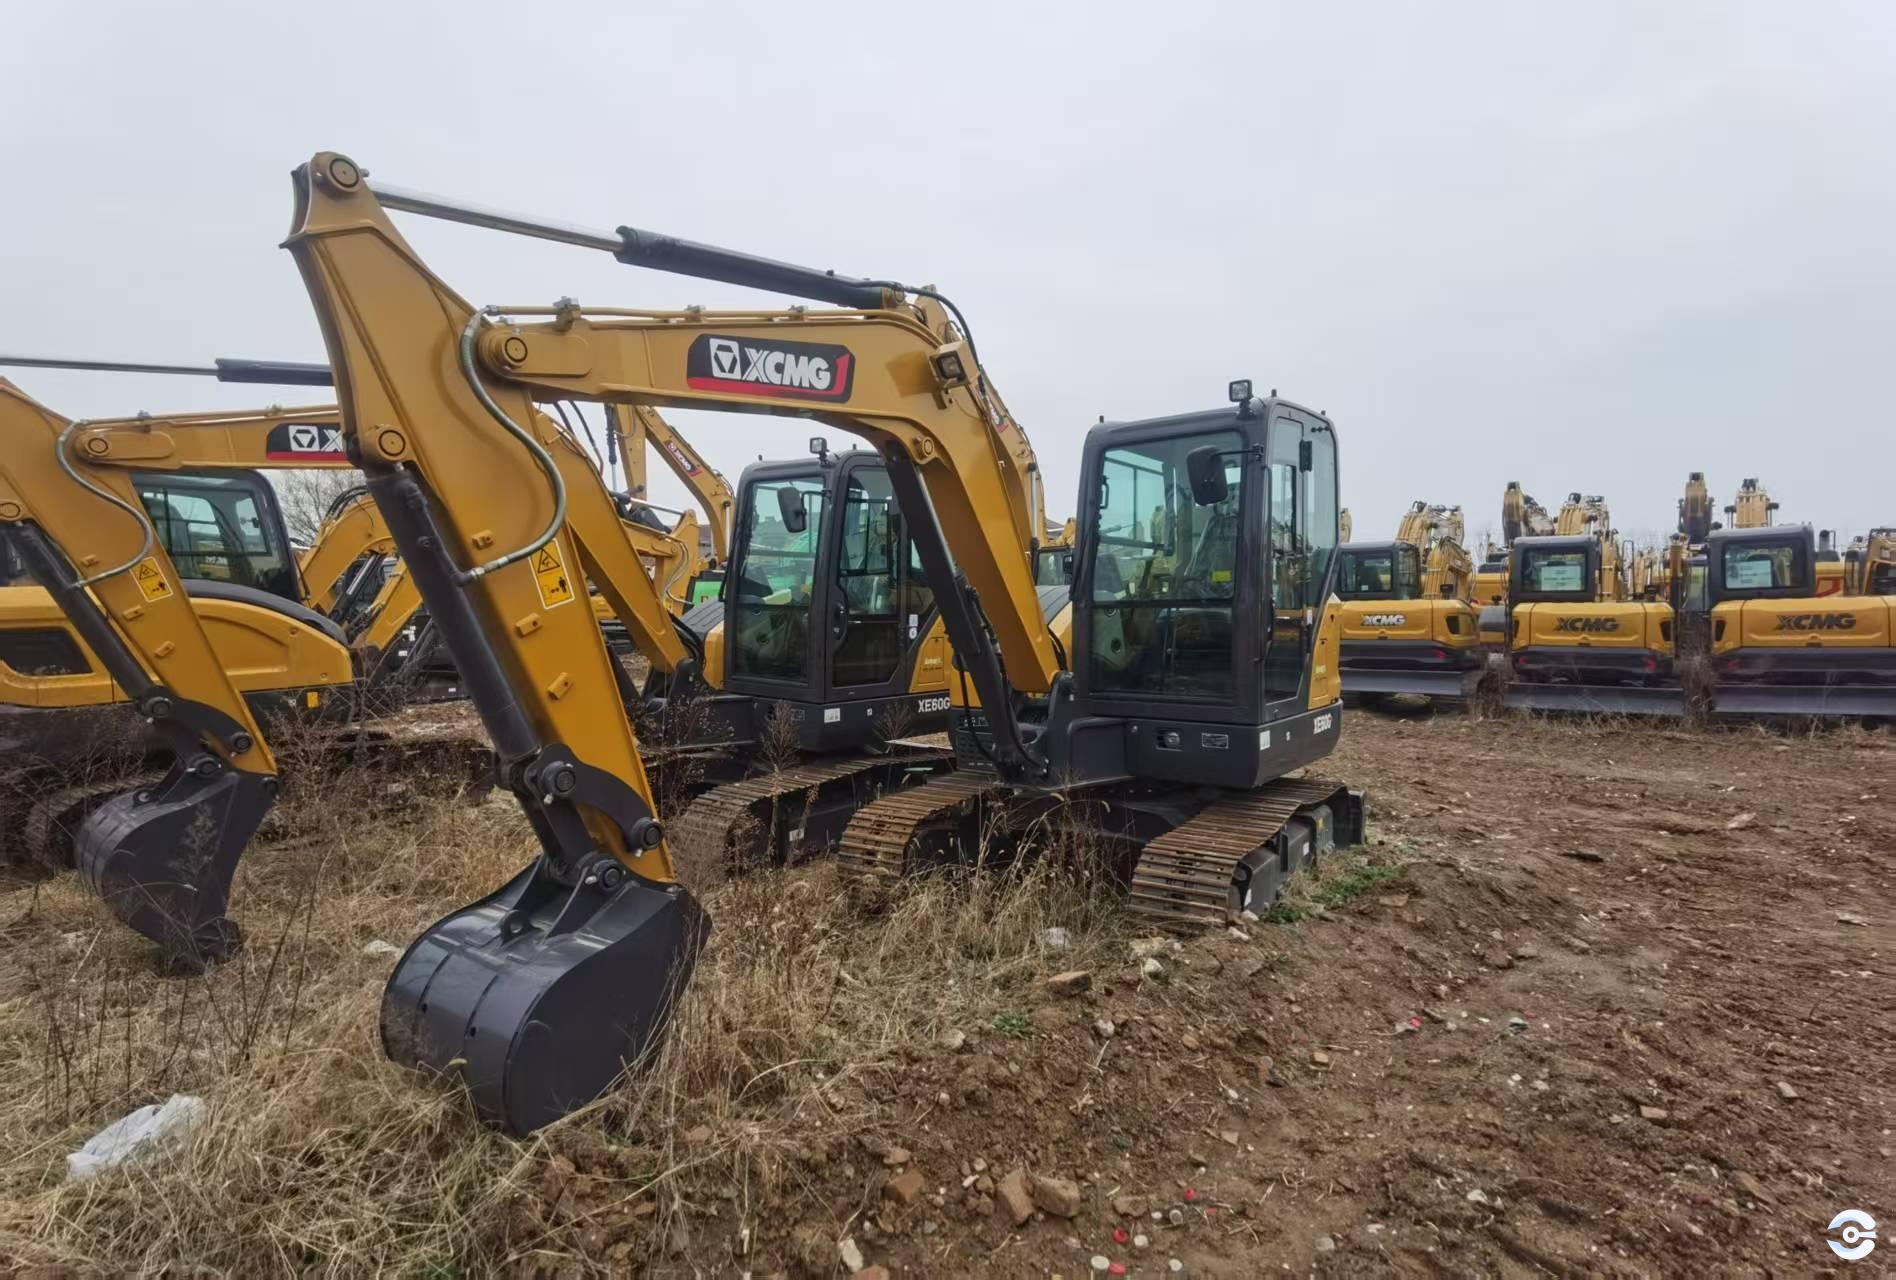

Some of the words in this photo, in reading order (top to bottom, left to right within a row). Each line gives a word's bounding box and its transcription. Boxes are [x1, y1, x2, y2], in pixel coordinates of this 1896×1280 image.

[742, 347, 831, 390] XCMG
[1360, 614, 1405, 628] XCMG
[1554, 617, 1620, 633] XCMG
[1774, 613, 1857, 632] XCMG
